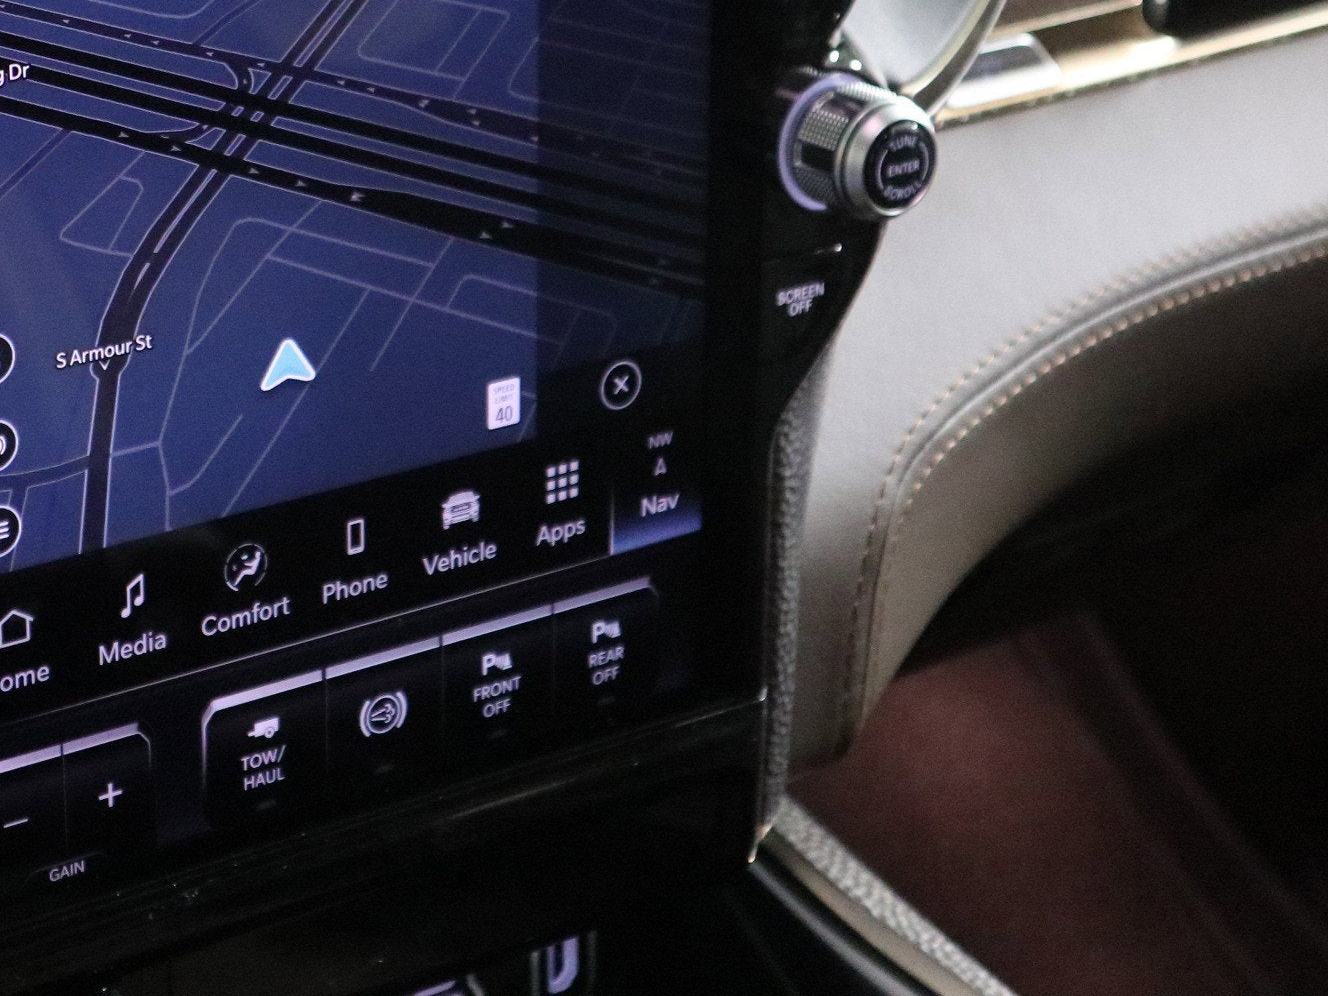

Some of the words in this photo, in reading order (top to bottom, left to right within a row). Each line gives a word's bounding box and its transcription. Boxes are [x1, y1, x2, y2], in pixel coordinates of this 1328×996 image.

[9, 63, 30, 81] Dr
[887, 159, 920, 178] ENTER
[777, 282, 825, 306] SCREEN
[787, 300, 813, 317] OFF
[56, 353, 67, 369] S
[70, 342, 133, 366] Armour
[135, 336, 153, 353] St
[495, 405, 513, 423] 40
[648, 432, 673, 450] NW
[640, 493, 680, 518] Nav
[536, 517, 586, 547] Apps
[422, 541, 497, 576] Vehicle
[322, 572, 388, 604] Phone
[201, 597, 291, 637] Comfort
[98, 631, 167, 666] Media
[588, 645, 625, 668] REAR
[592, 665, 620, 685] OFF
[473, 676, 521, 703] FRONT
[483, 698, 512, 718] OFF
[241, 745, 287, 772] TOW/
[243, 768, 286, 791] HAUL
[49, 860, 86, 883] GAIN
